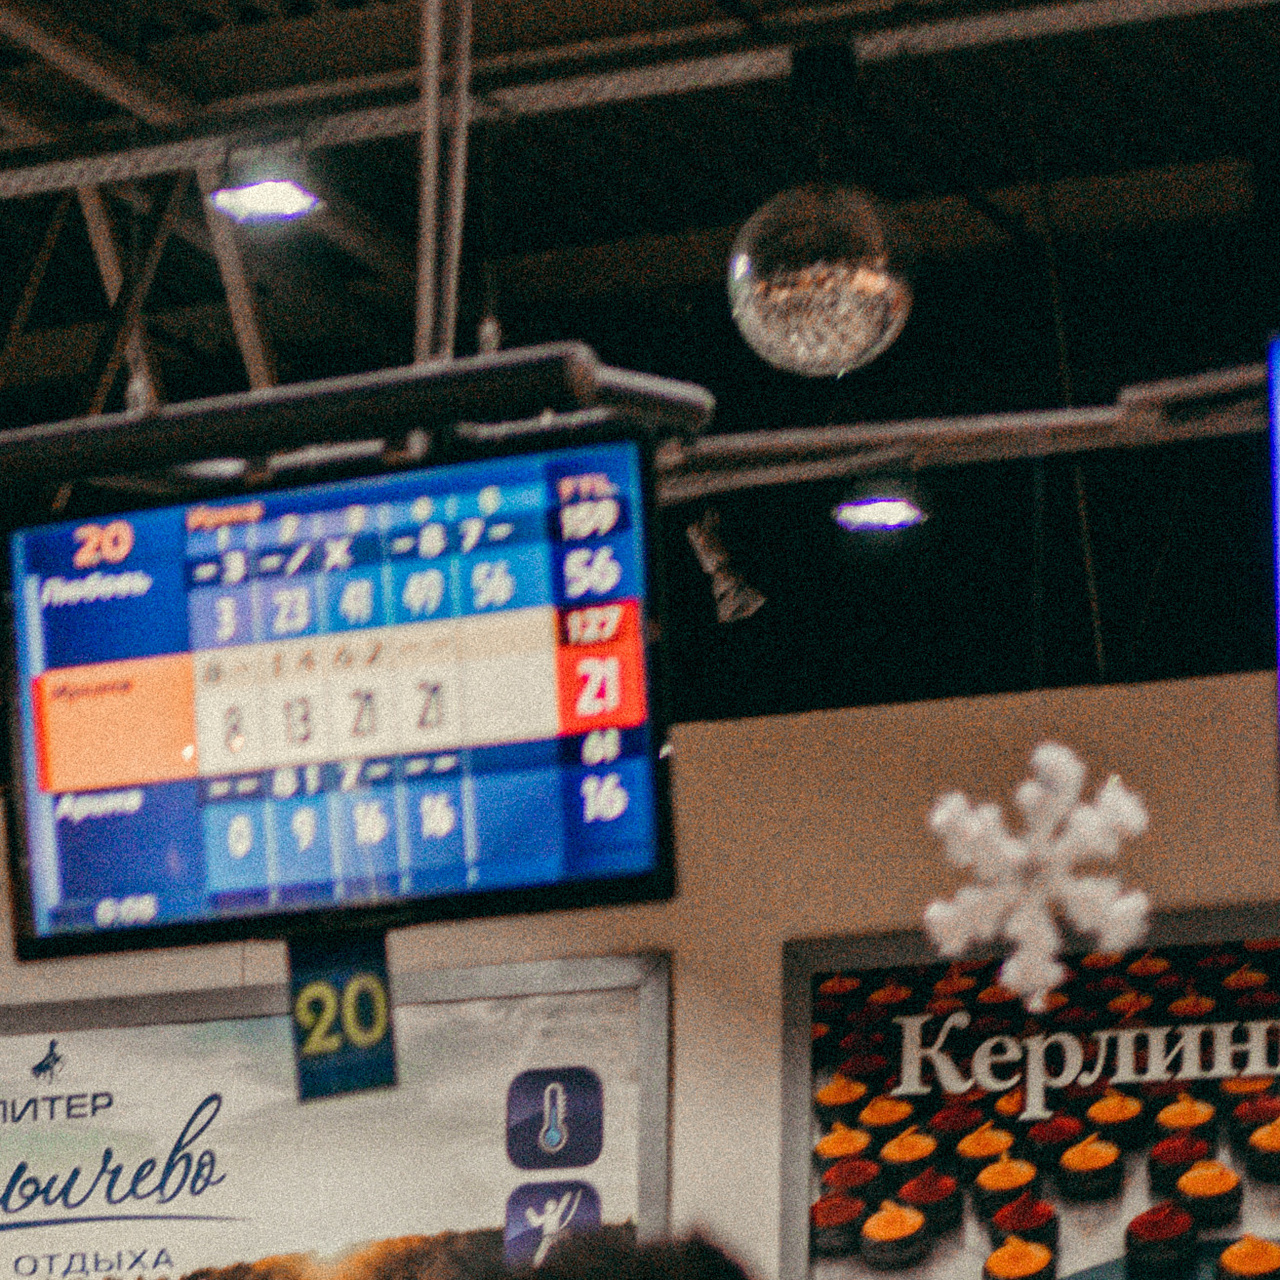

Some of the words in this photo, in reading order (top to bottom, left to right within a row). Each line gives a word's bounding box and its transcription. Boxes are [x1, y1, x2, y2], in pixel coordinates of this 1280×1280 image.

[74, 519, 135, 570] 20
[564, 545, 622, 598] 56
[273, 586, 312, 635] 23
[575, 655, 620, 717] 21
[580, 772, 629, 823] 16
[294, 974, 389, 1057] 20
[890, 1010, 1280, 1122] Керлин
[14, 1248, 175, 1279] ОТДЫХА
